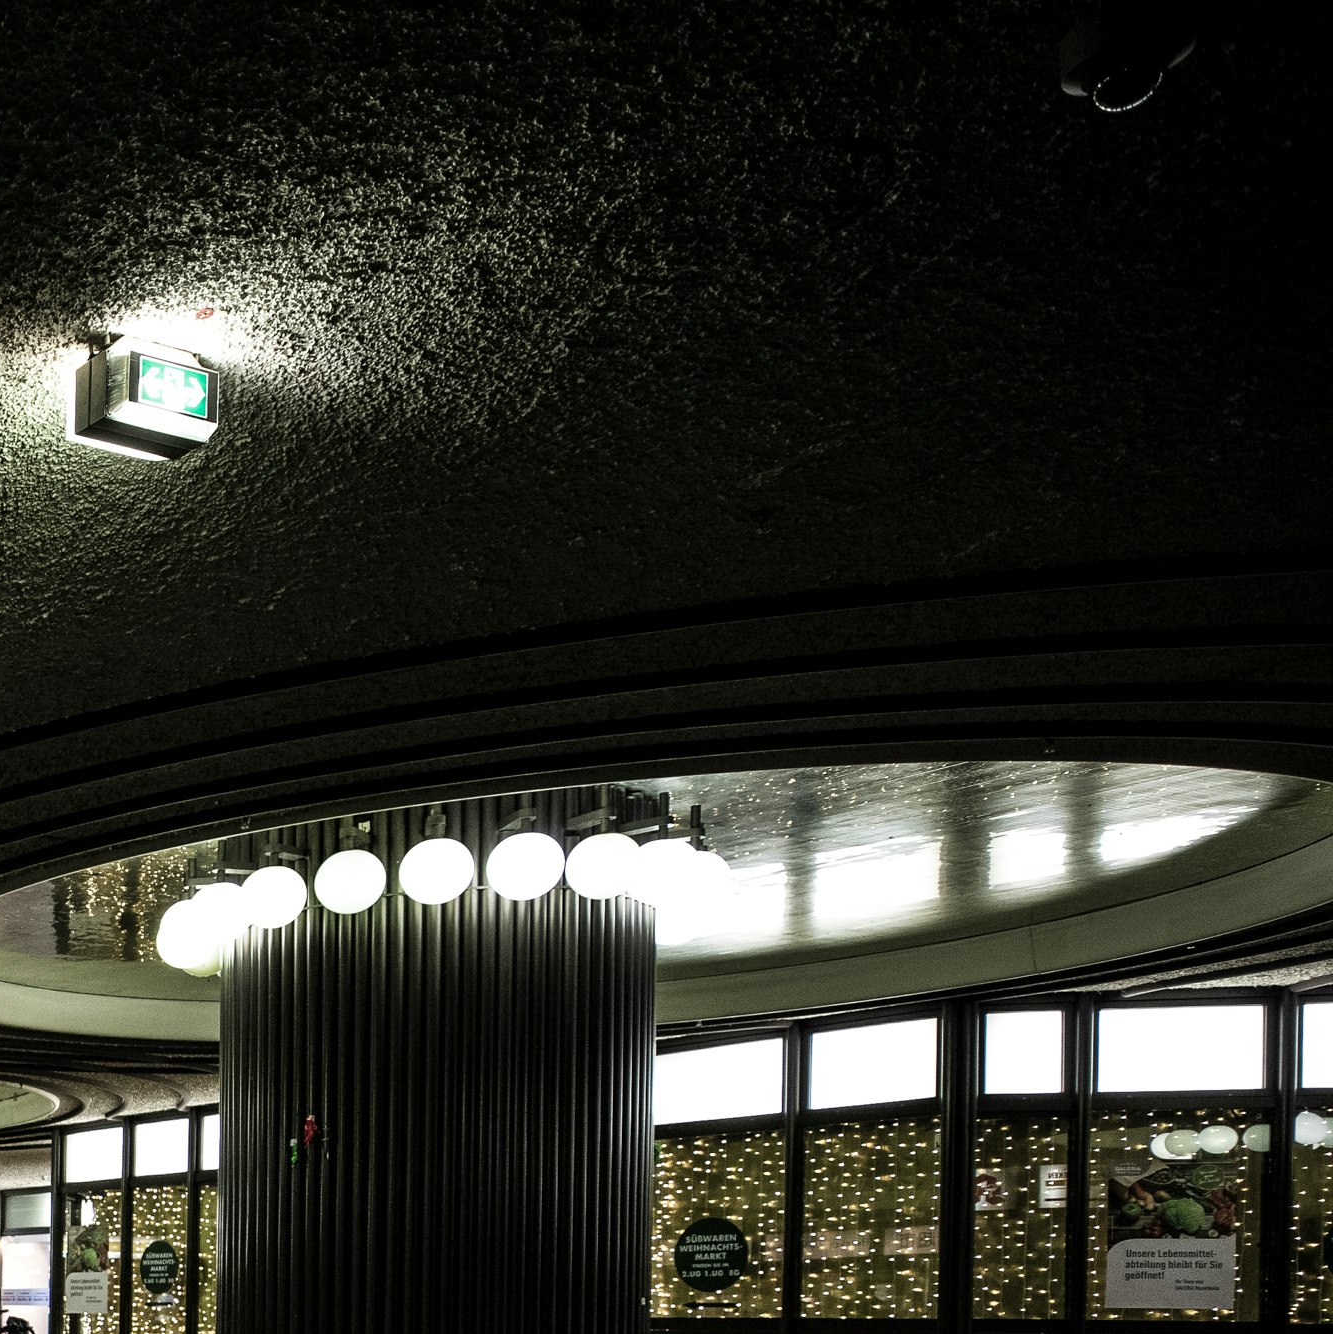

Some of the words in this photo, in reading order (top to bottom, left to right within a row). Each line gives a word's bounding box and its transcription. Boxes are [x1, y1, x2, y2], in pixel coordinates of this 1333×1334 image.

[679, 1243, 743, 1252] WEIHNACHTS-
[695, 1252, 727, 1260] MARKT
[1126, 1250, 1155, 1258] Unsere
[1158, 1250, 1217, 1258] Lebensmittel-
[1125, 1260, 1166, 1270] abteilung
[1168, 1260, 1193, 1268] bleibt
[1195, 1260, 1208, 1268] für
[1209, 1261, 1223, 1269] Sie
[682, 1270, 702, 1278] 2.UG
[704, 1269, 724, 1277] 1.UG
[1125, 1271, 1165, 1281] geöffnet!
